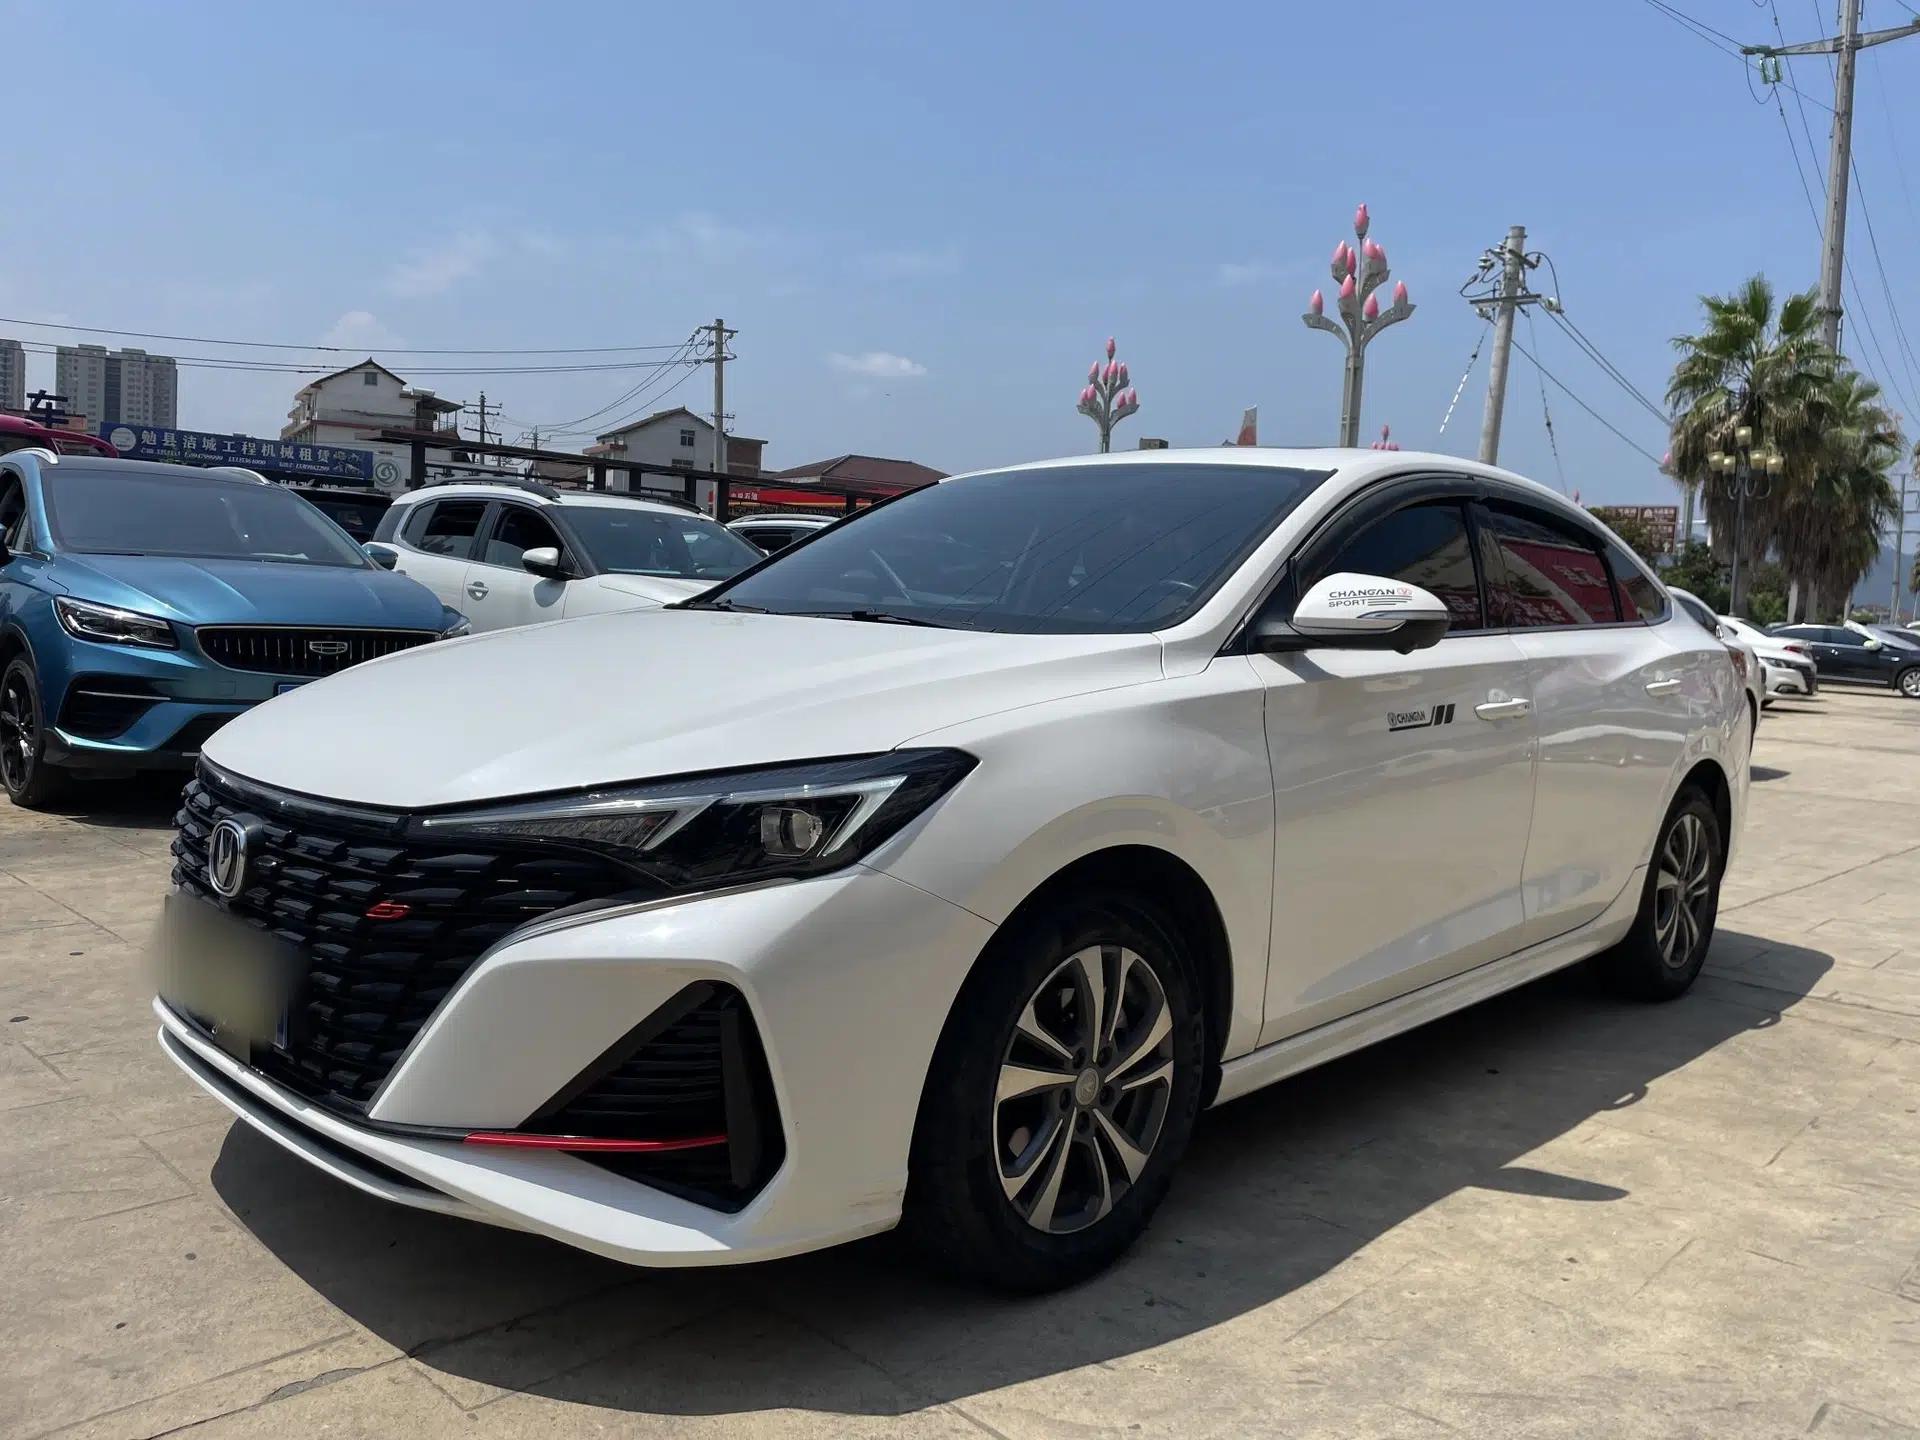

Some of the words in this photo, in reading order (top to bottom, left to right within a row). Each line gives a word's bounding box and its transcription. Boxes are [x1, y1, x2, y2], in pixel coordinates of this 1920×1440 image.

[141, 430, 330, 463] 勉县洁城工程机械租赁
[1329, 588, 1395, 598] CHANGAN
[1328, 599, 1366, 608] SPORT
[1396, 710, 1426, 724] CHANGAN
